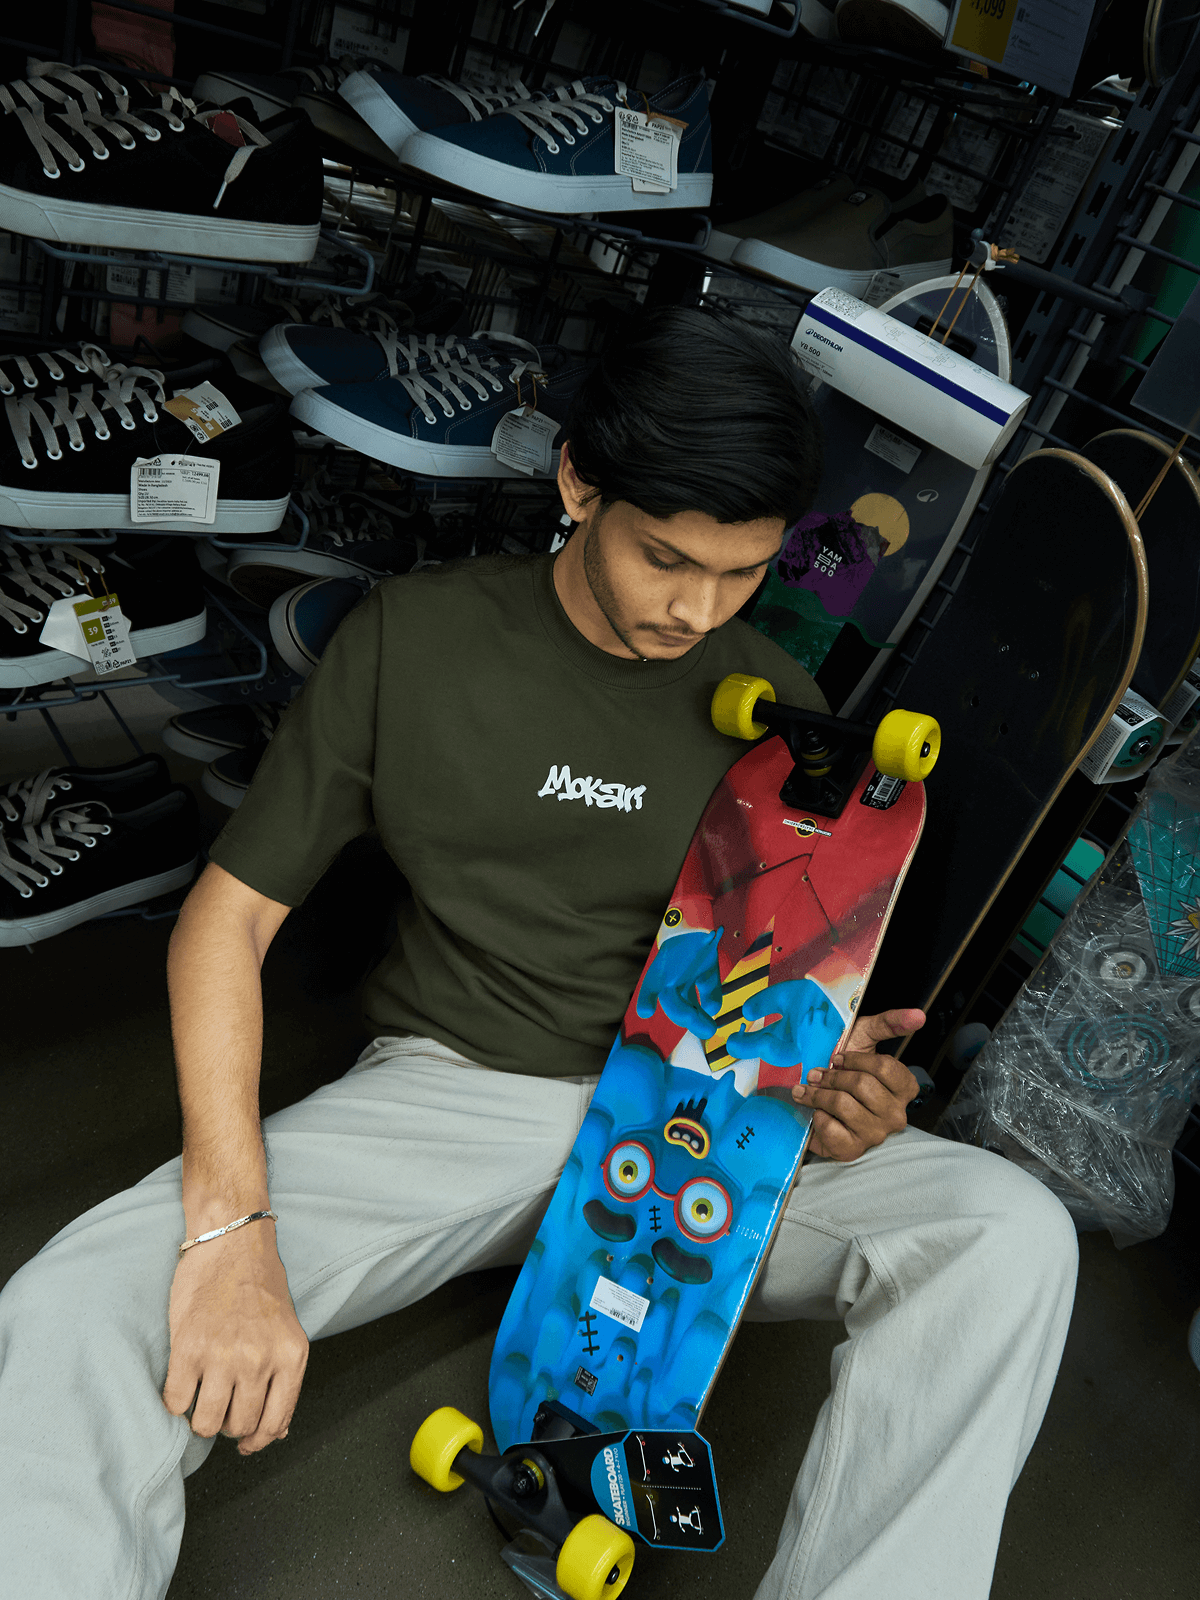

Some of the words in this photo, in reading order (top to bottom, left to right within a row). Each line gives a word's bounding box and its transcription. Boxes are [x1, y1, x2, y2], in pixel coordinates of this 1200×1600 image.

[800, 341, 809, 350] YB
[808, 346, 821, 357] 500
[812, 331, 844, 353] DECATHLON
[813, 561, 834, 577] 500
[109, 597, 116, 605] 39
[88, 626, 99, 636] 39
[603, 1447, 625, 1526] SKATEBOARD
[622, 1500, 632, 1527] BEGINNER
